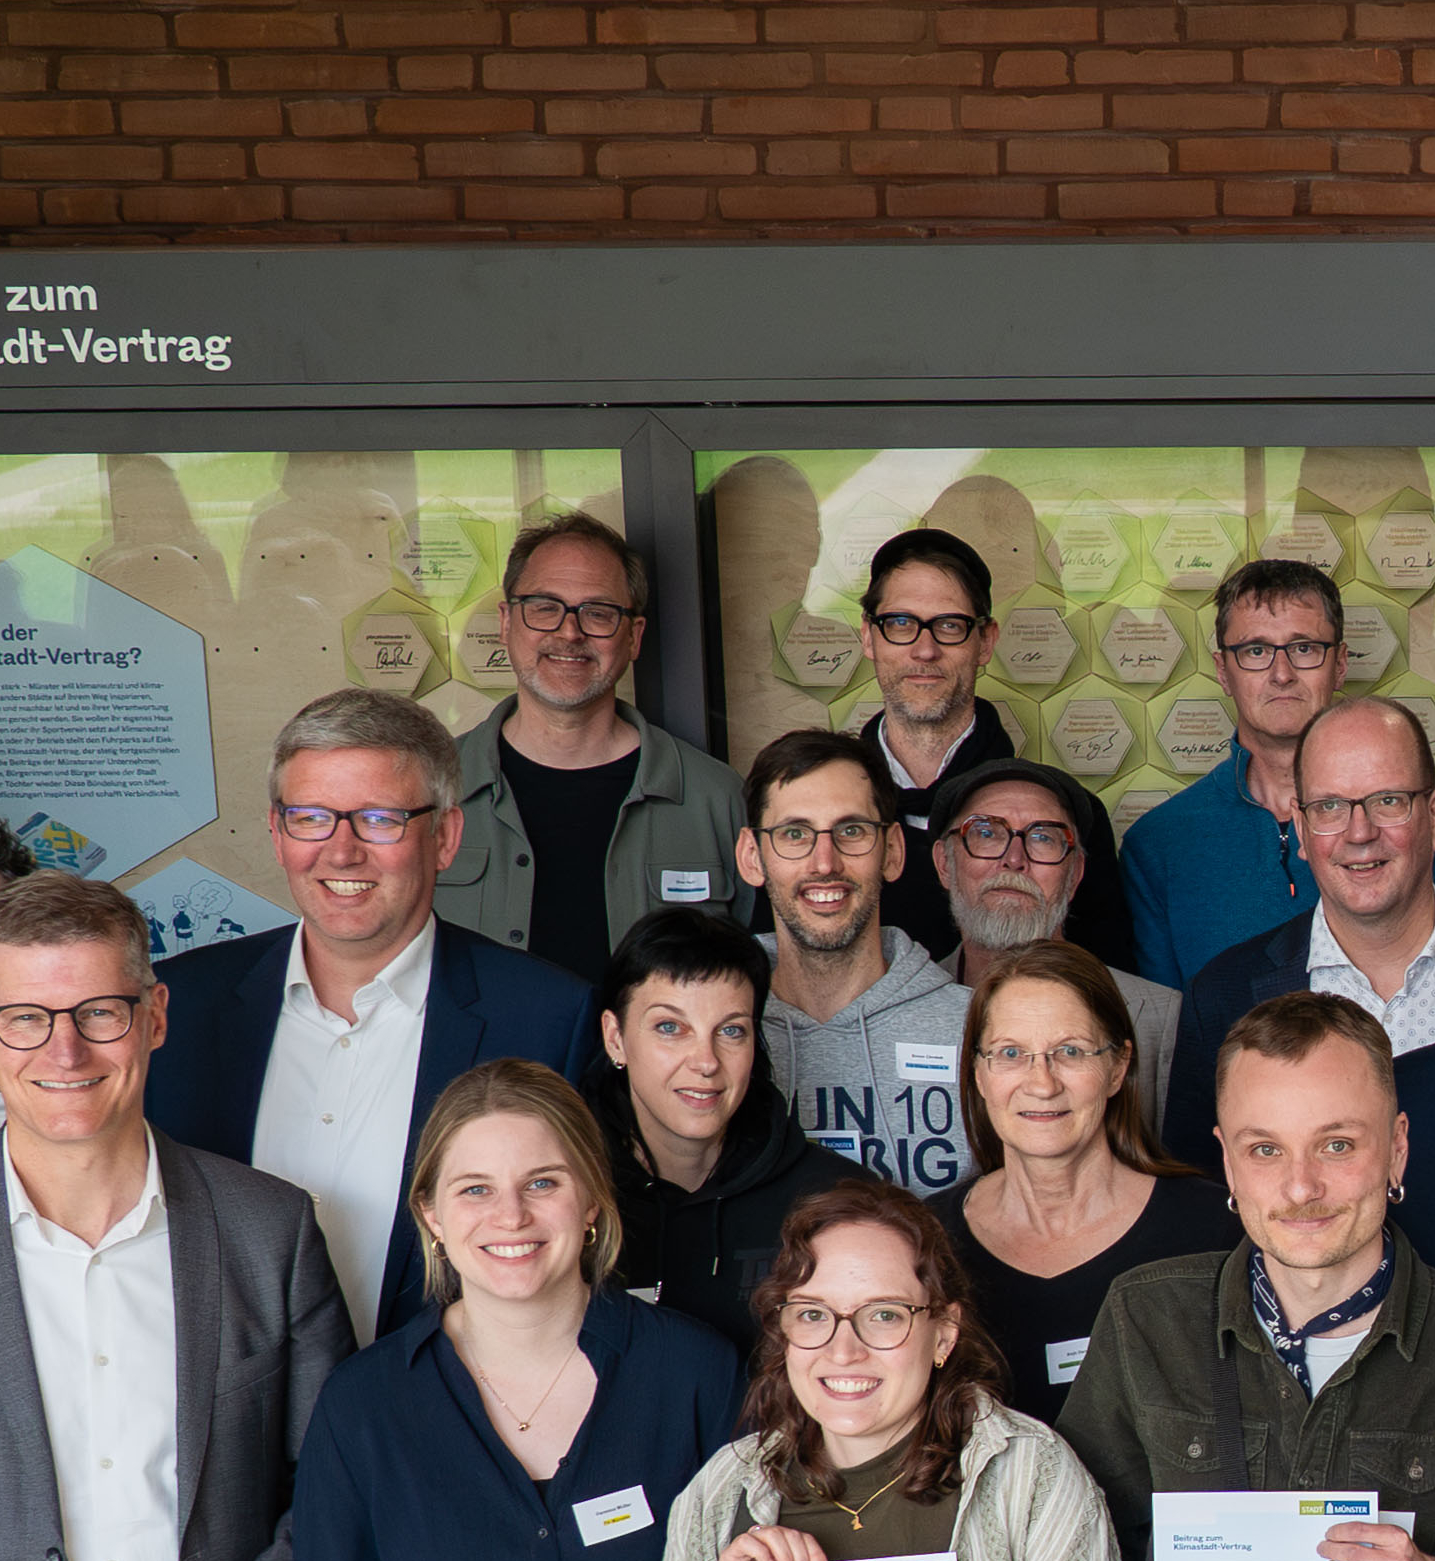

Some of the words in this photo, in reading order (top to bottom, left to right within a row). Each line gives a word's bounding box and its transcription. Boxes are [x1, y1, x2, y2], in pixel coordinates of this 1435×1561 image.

[4, 285, 97, 313] zum
[2, 624, 38, 641] der
[790, 1086, 875, 1135] UN
[895, 1086, 953, 1135] 10
[1335, 1504, 1368, 1513] MÜNSTER
[1173, 1534, 1203, 1543] Beitrag
[1173, 1542, 1252, 1551] Klimastadt-Vertrag
